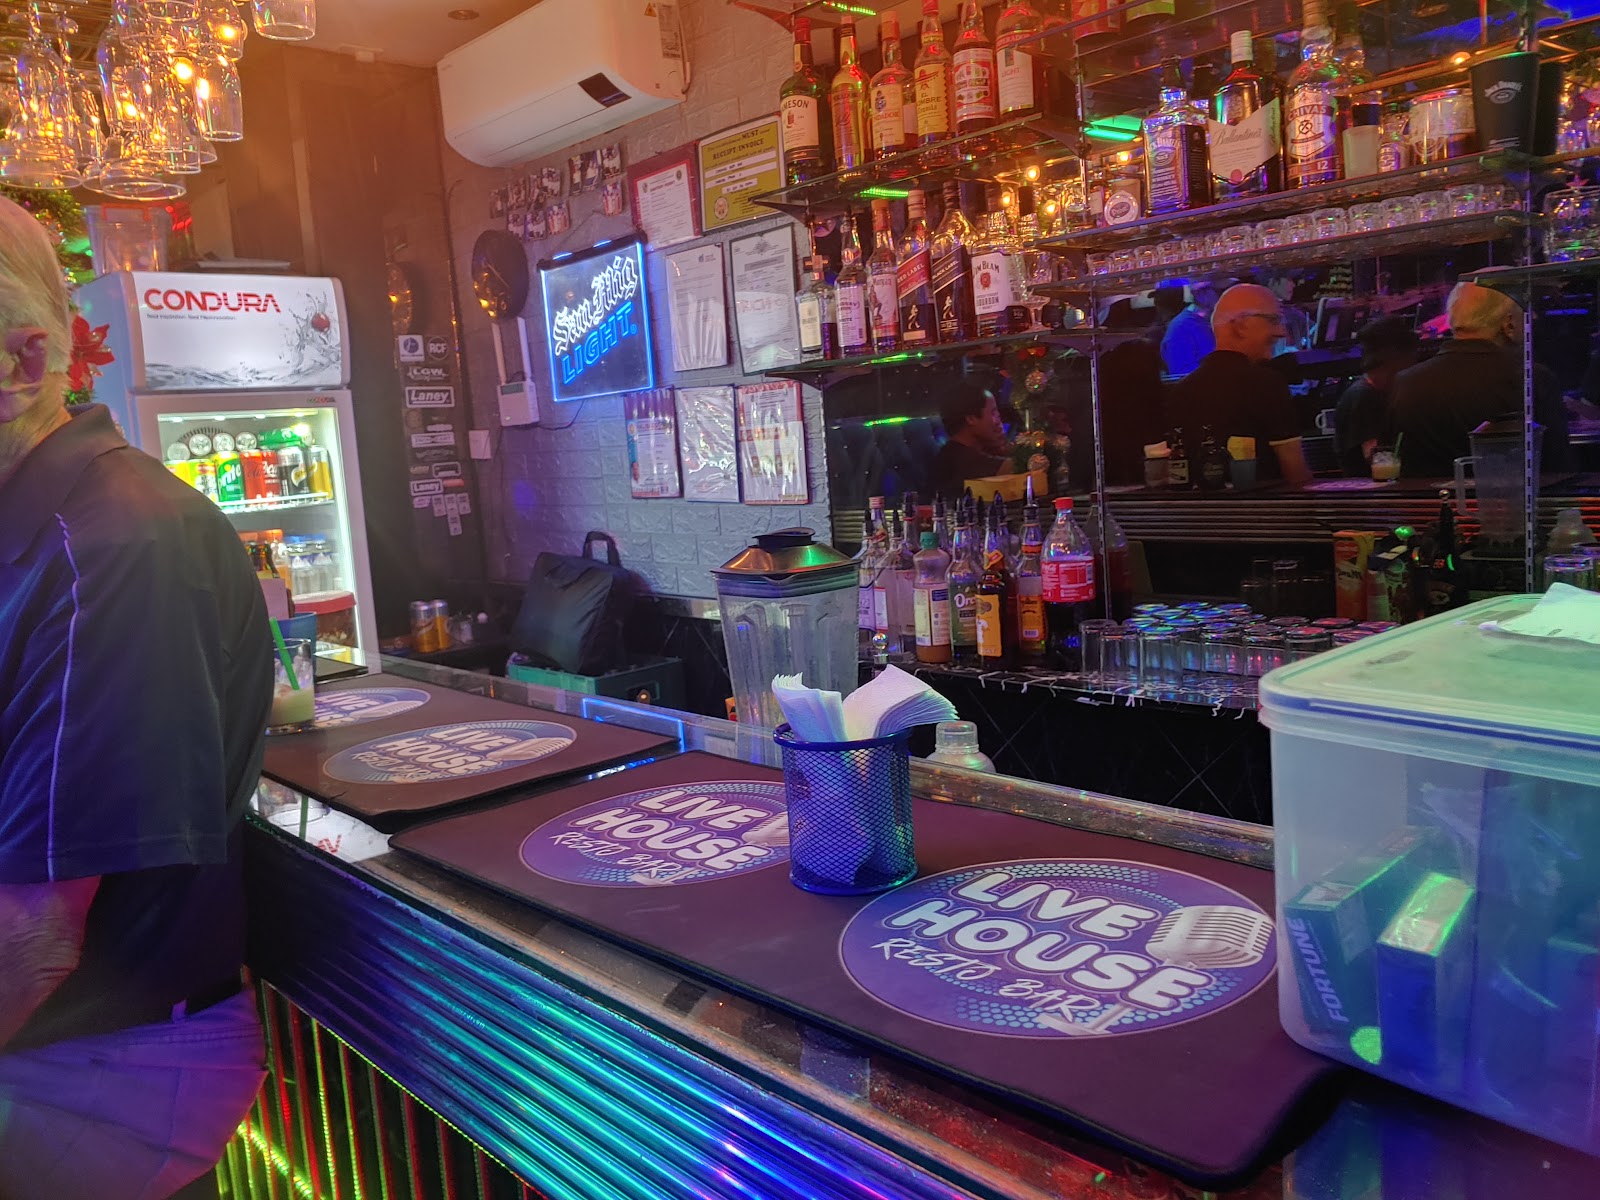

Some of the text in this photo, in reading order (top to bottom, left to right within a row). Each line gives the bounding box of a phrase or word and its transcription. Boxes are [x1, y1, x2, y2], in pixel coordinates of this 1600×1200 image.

[1288, 106, 1327, 121] CHIVAS
[738, 138, 765, 151] INVOICE
[1317, 160, 1329, 170] 12
[907, 263, 925, 277] LABEL
[981, 260, 1000, 273] BEAM
[144, 288, 282, 313] CONDURA
[411, 389, 449, 403] Laney
[429, 726, 518, 750] LIVE
[375, 737, 499, 775] HOUSE
[638, 790, 770, 829] LIVE
[575, 808, 769, 870] HOUSE
[550, 831, 682, 880] RESTO BAR
[958, 871, 1159, 939] LIVE
[890, 900, 1212, 1009] HOUSE
[1286, 916, 1349, 1024] FORTUNE
[870, 937, 1101, 1023] RESTO BAR
